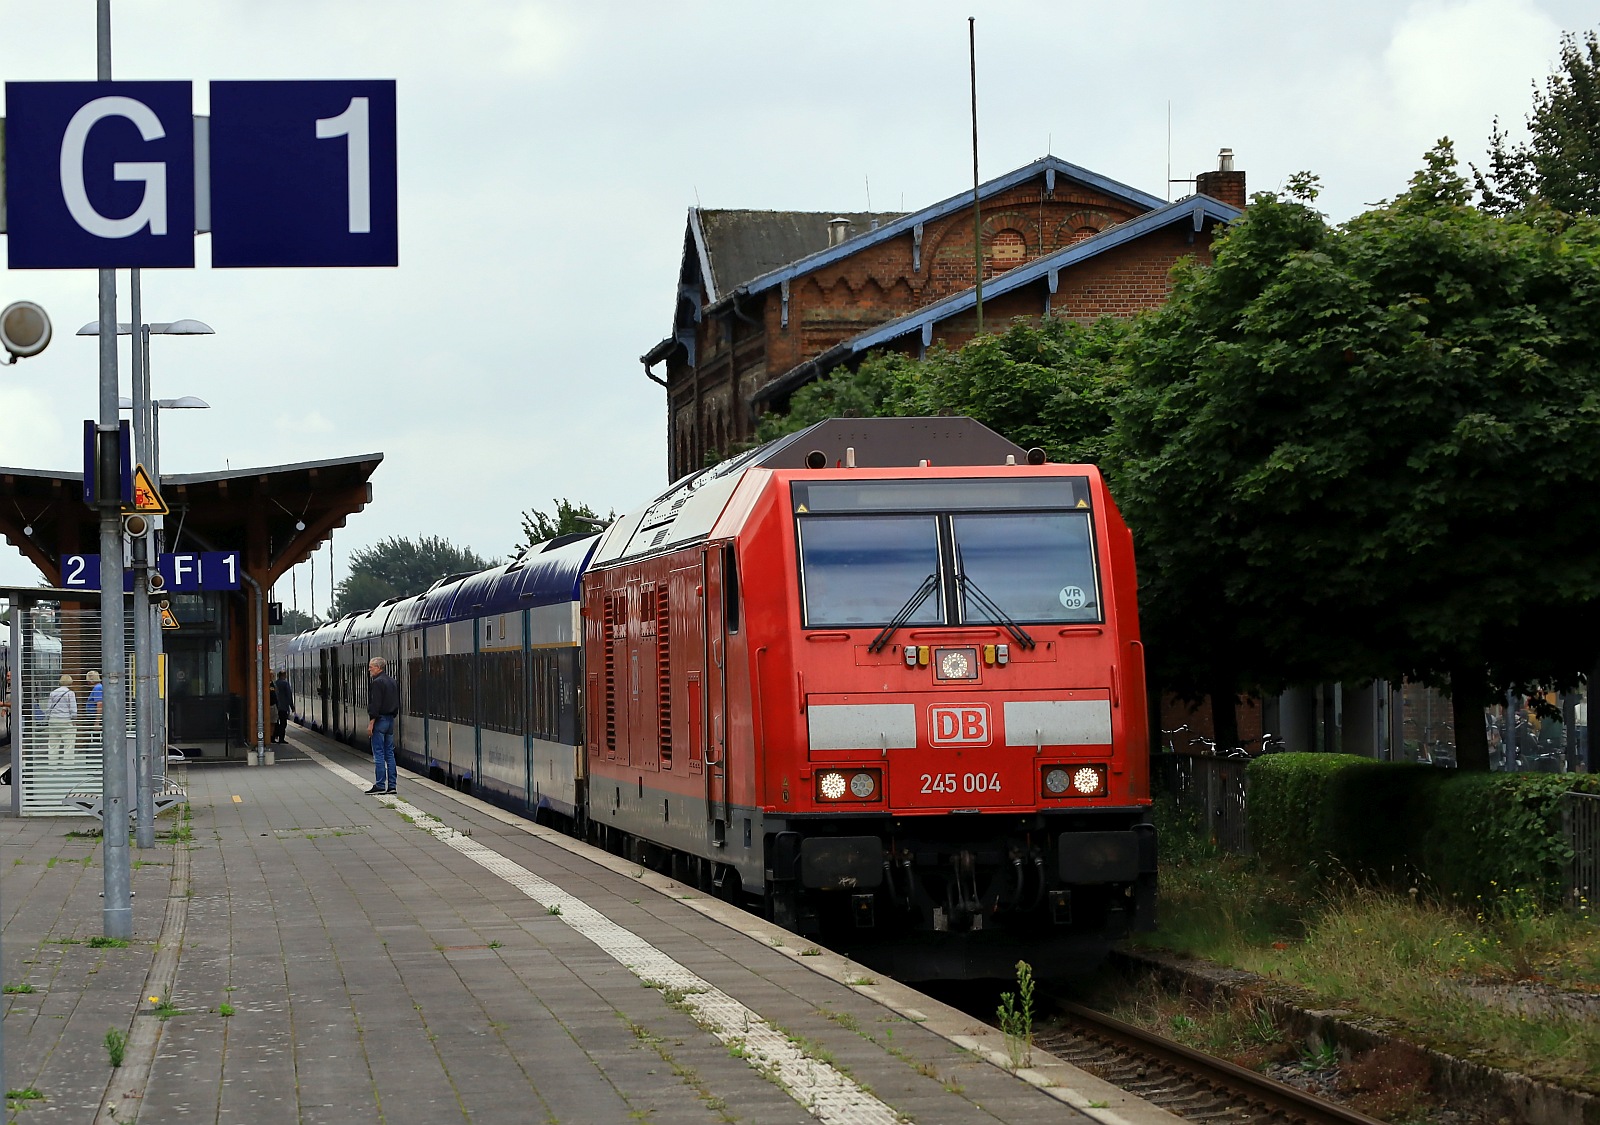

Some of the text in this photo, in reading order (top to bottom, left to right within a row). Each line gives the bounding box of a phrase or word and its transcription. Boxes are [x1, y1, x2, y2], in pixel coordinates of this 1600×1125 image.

[60, 95, 371, 239] G 1
[66, 555, 86, 585] 2
[174, 554, 236, 585] F 1
[1064, 588, 1081, 597] VR
[1066, 599, 1081, 607] 09
[272, 603, 280, 620] 1
[936, 710, 985, 740] DB
[920, 772, 1002, 793] 245 004
